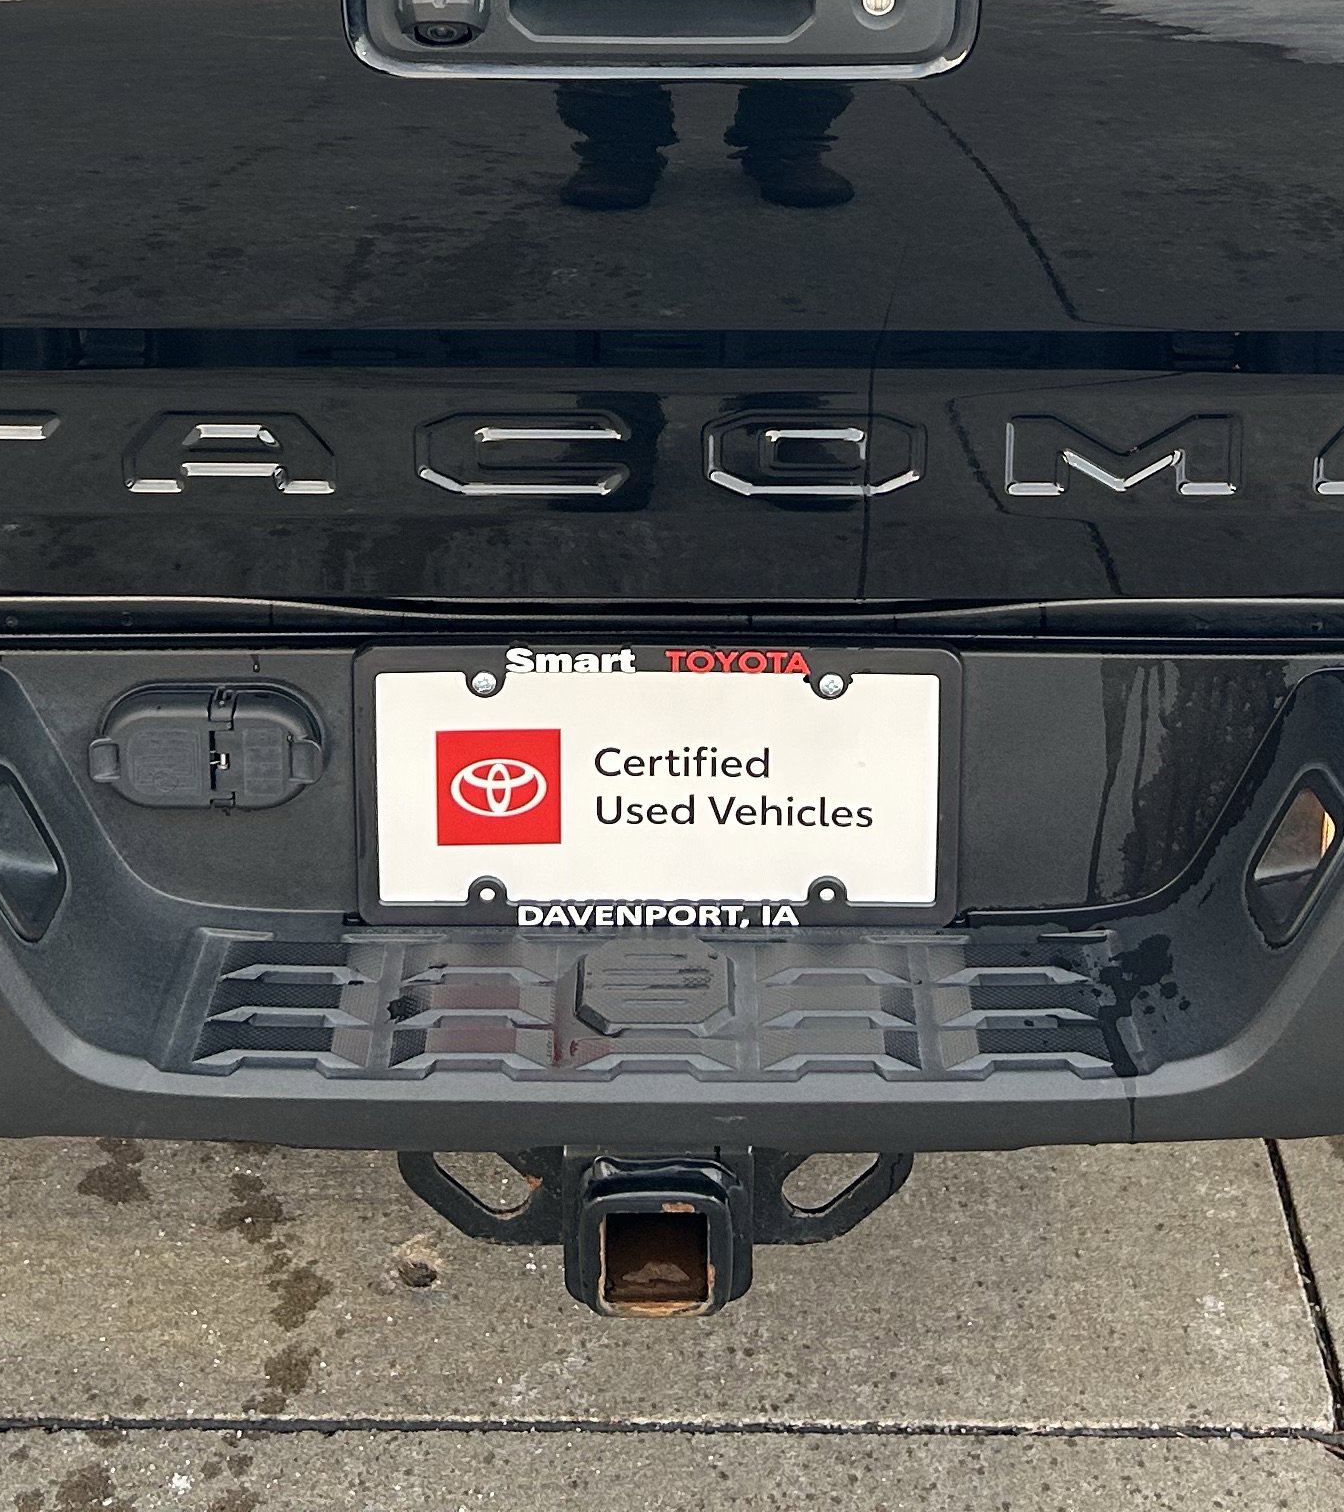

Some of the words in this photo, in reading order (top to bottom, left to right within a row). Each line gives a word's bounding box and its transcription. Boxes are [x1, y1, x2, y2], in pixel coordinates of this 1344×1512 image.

[505, 646, 637, 674] Smart
[664, 649, 811, 675] TOYOTA
[594, 746, 770, 779] Certified
[595, 794, 695, 826] Used
[708, 796, 874, 828] Vehicles
[516, 903, 751, 928] DAVENPORT,
[761, 904, 800, 927] IA
